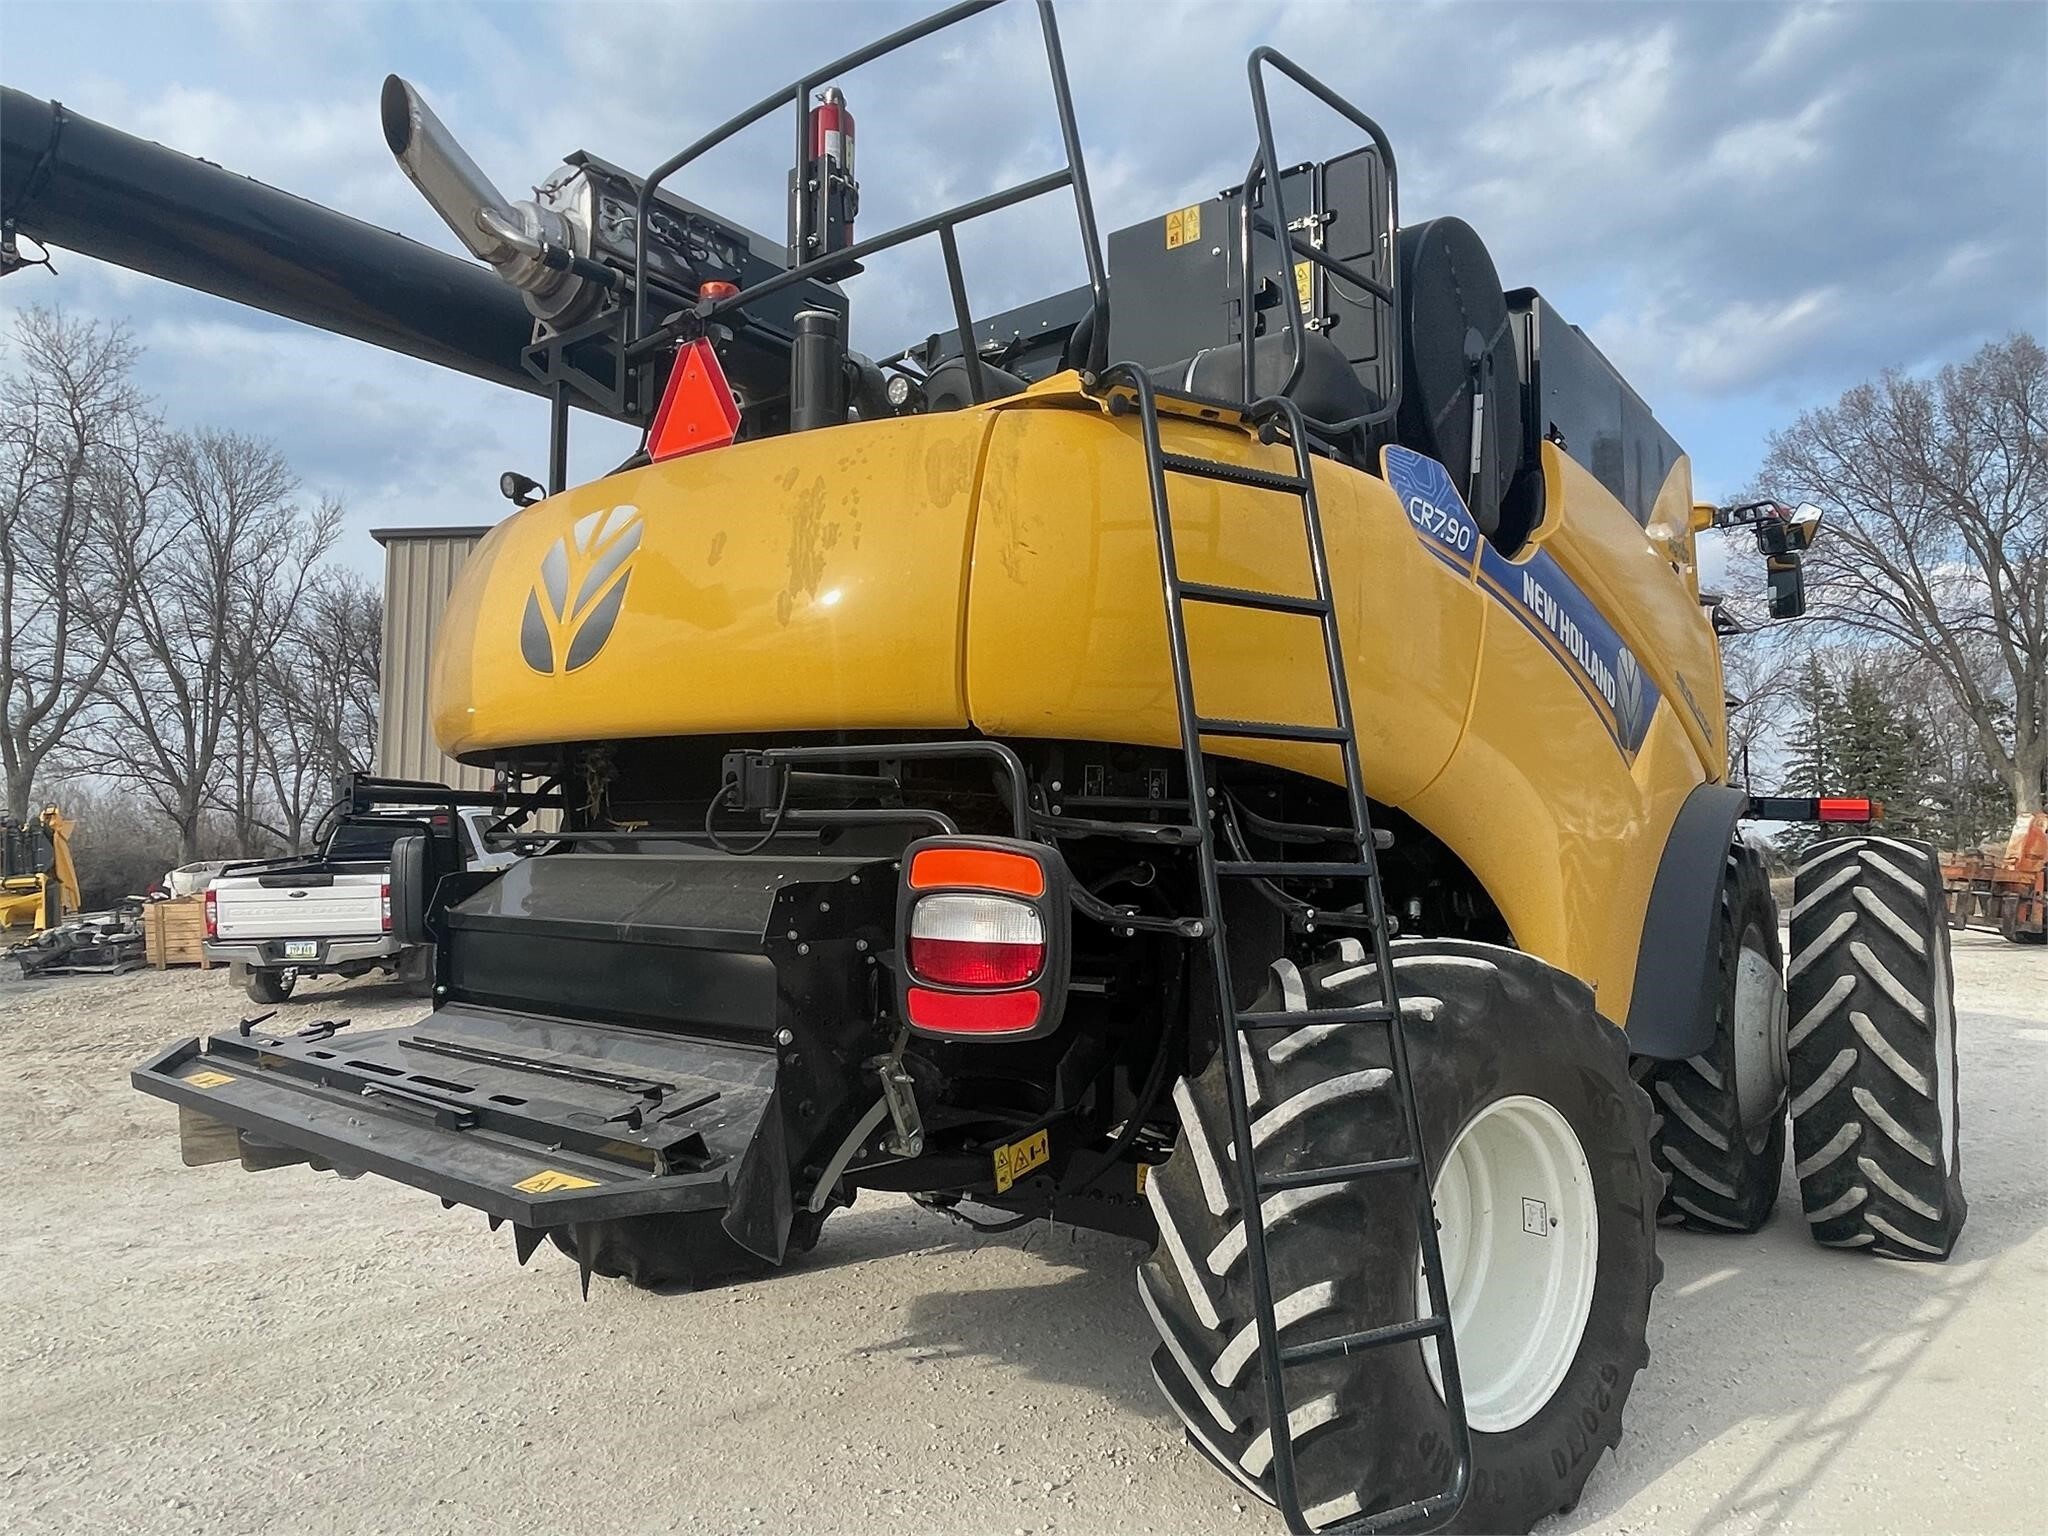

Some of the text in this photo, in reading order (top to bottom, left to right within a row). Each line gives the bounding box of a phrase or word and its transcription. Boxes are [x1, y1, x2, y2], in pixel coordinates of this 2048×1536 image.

[1410, 496, 1471, 552] CR7.90
[1522, 570, 1617, 709] NEW HOLLAND
